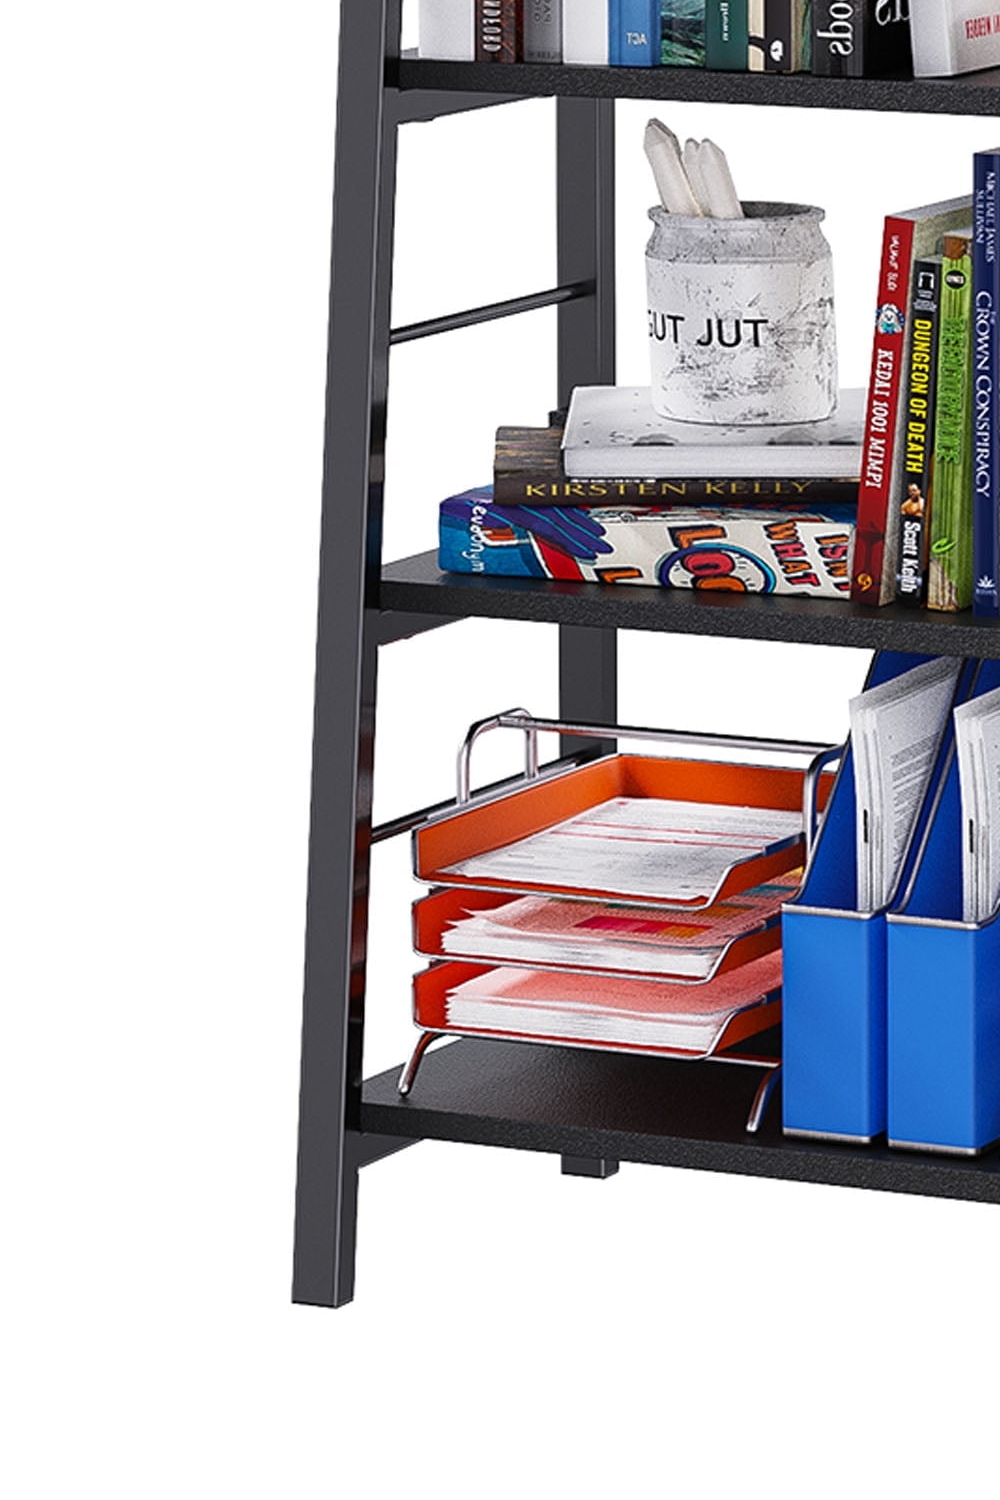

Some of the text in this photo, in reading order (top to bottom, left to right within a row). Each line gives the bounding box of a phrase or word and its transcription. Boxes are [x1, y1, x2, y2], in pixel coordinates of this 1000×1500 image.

[696, 318, 769, 348] JUT
[909, 319, 932, 394] DUNGEON
[864, 348, 893, 488] KEDAI 1001 MIMPI
[908, 398, 926, 417] OF
[974, 291, 992, 499] CROWN CONSPIRACY
[905, 422, 925, 474] DEATH
[526, 479, 814, 497] KIRSTEN KELLY
[763, 521, 821, 588] WHAT
[899, 521, 921, 594] Scott Keith
